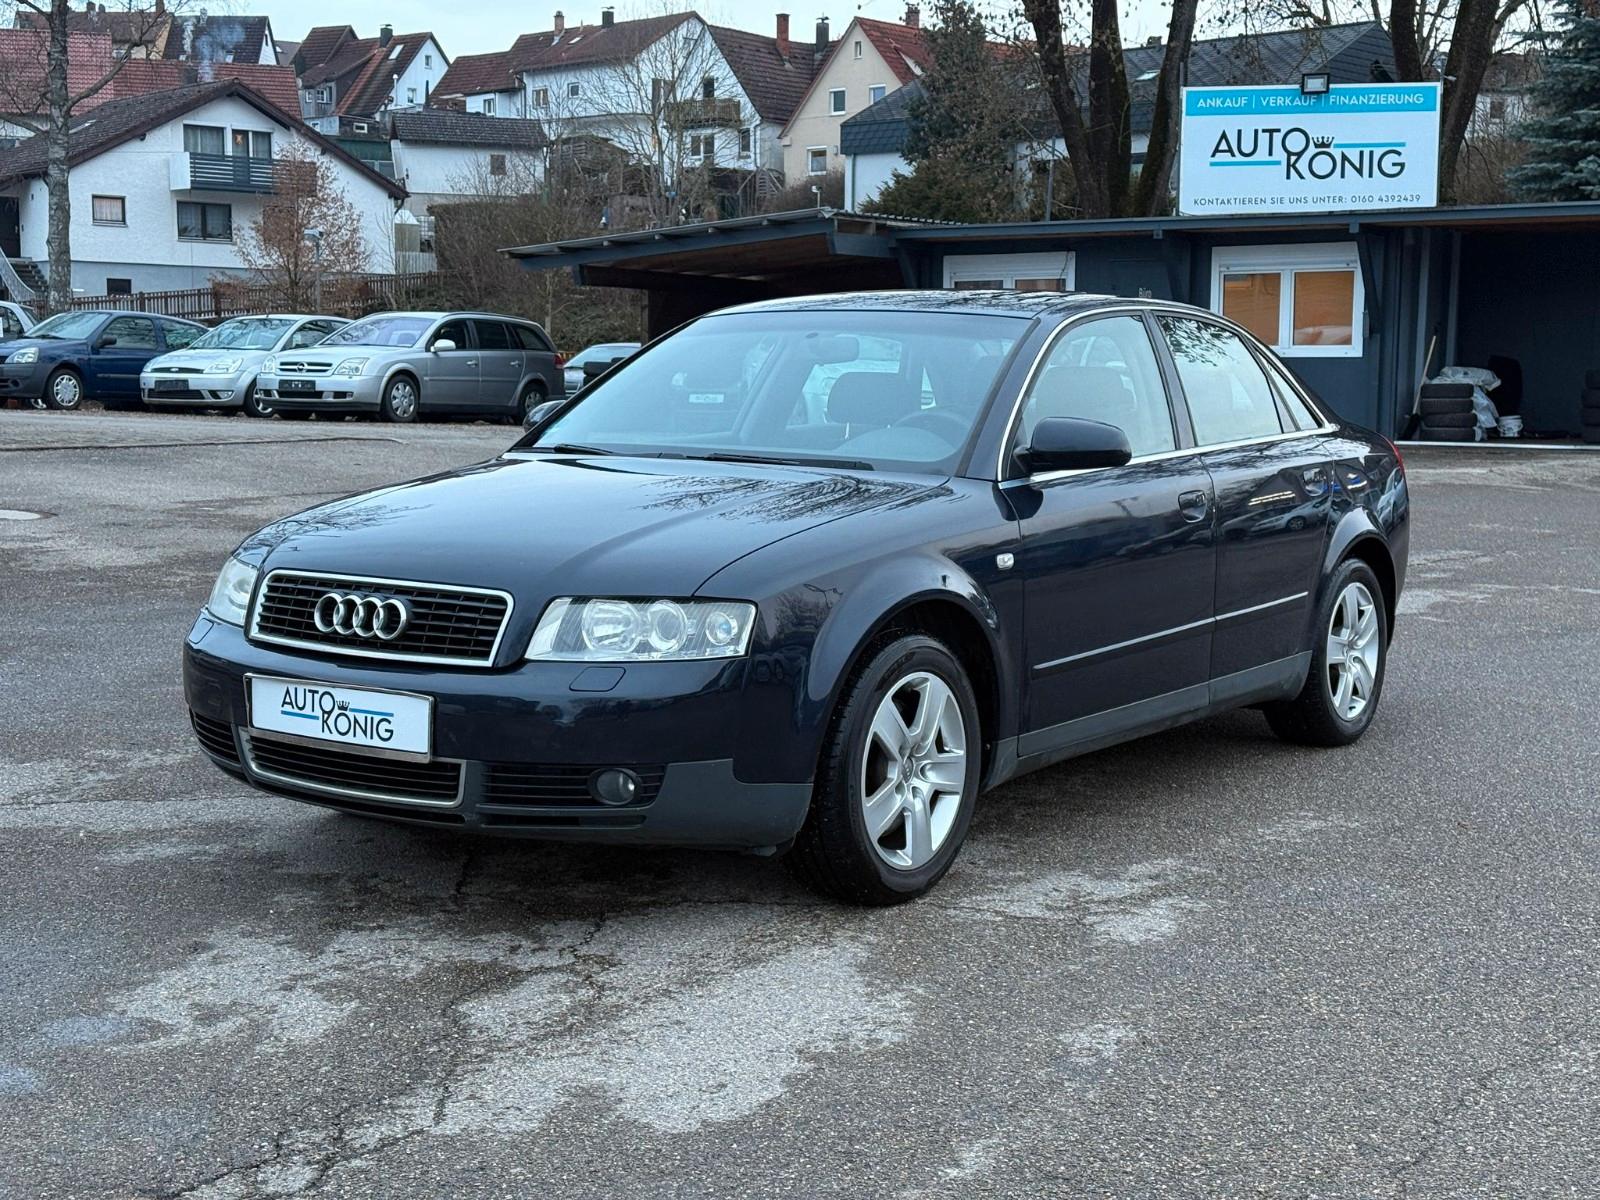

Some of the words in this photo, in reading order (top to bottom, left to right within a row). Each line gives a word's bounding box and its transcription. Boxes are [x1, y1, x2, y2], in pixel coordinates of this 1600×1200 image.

[1197, 96, 1248, 108] ANKAUF
[1260, 95, 1317, 107] VERKAUF
[1329, 93, 1425, 106] FINANZIERUNG
[1210, 127, 1310, 158] AUTO
[1193, 197, 1267, 206] KONTAKTIEREN
[1270, 196, 1285, 205] SIE
[1288, 196, 1309, 205] UNS
[1312, 195, 1348, 204] UNTER:
[1350, 194, 1374, 203] 0160
[1377, 194, 1421, 203] 4392439
[281, 686, 336, 713] AUTO
